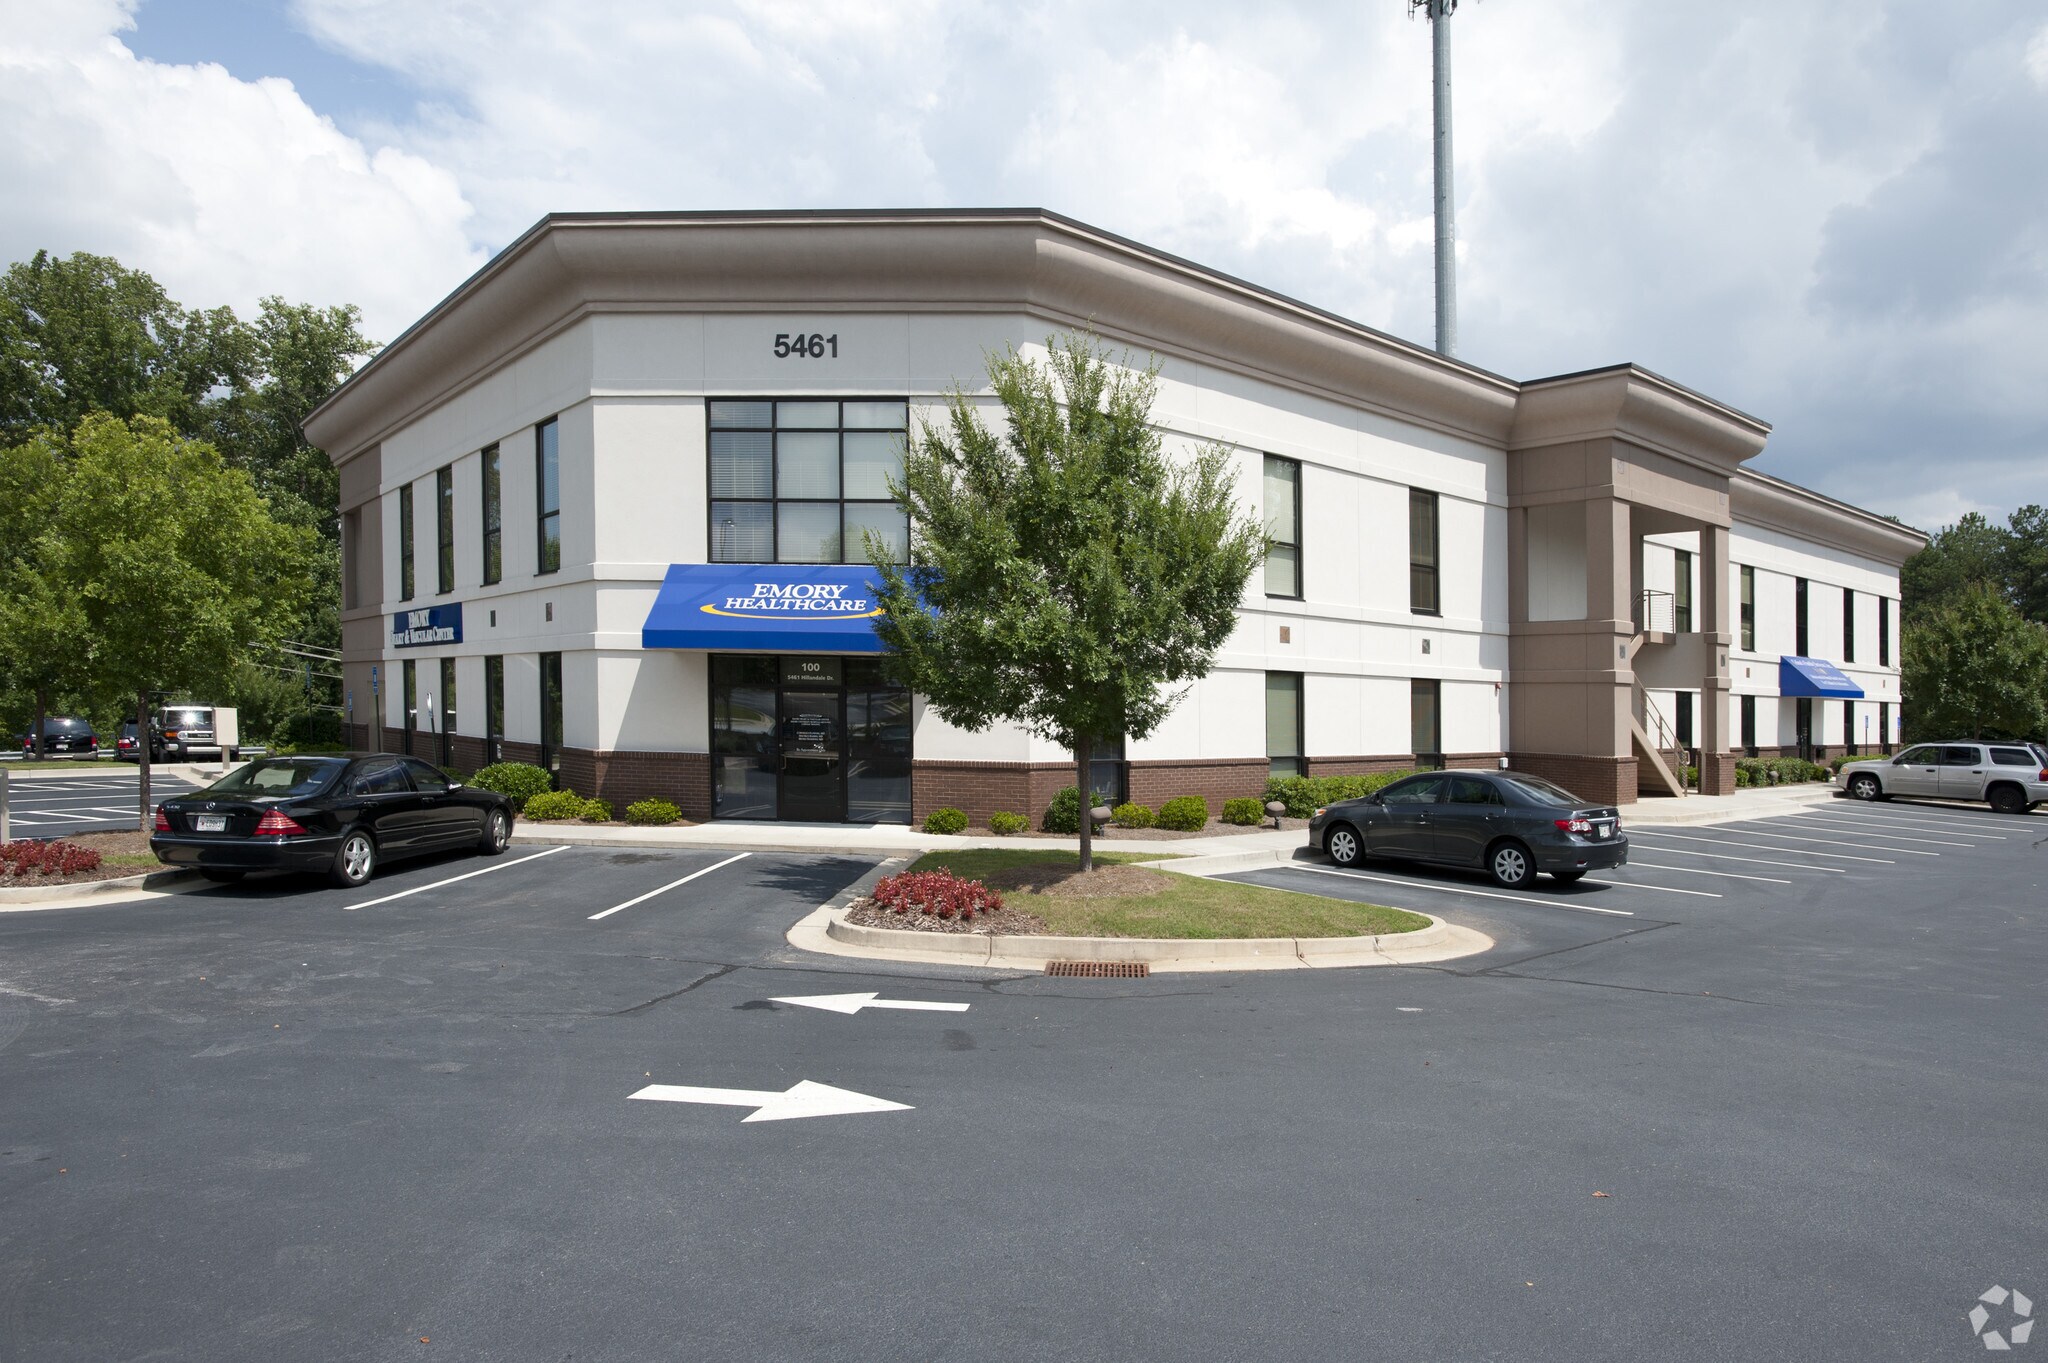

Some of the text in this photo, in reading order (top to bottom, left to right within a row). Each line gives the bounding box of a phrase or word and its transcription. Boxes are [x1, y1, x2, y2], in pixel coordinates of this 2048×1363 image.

[774, 334, 838, 358] 5461
[752, 583, 848, 599] EMORY
[724, 598, 867, 611] HEALTHCARE
[408, 609, 430, 628] EMORY
[433, 626, 454, 641] CENTER
[802, 663, 820, 671] 100
